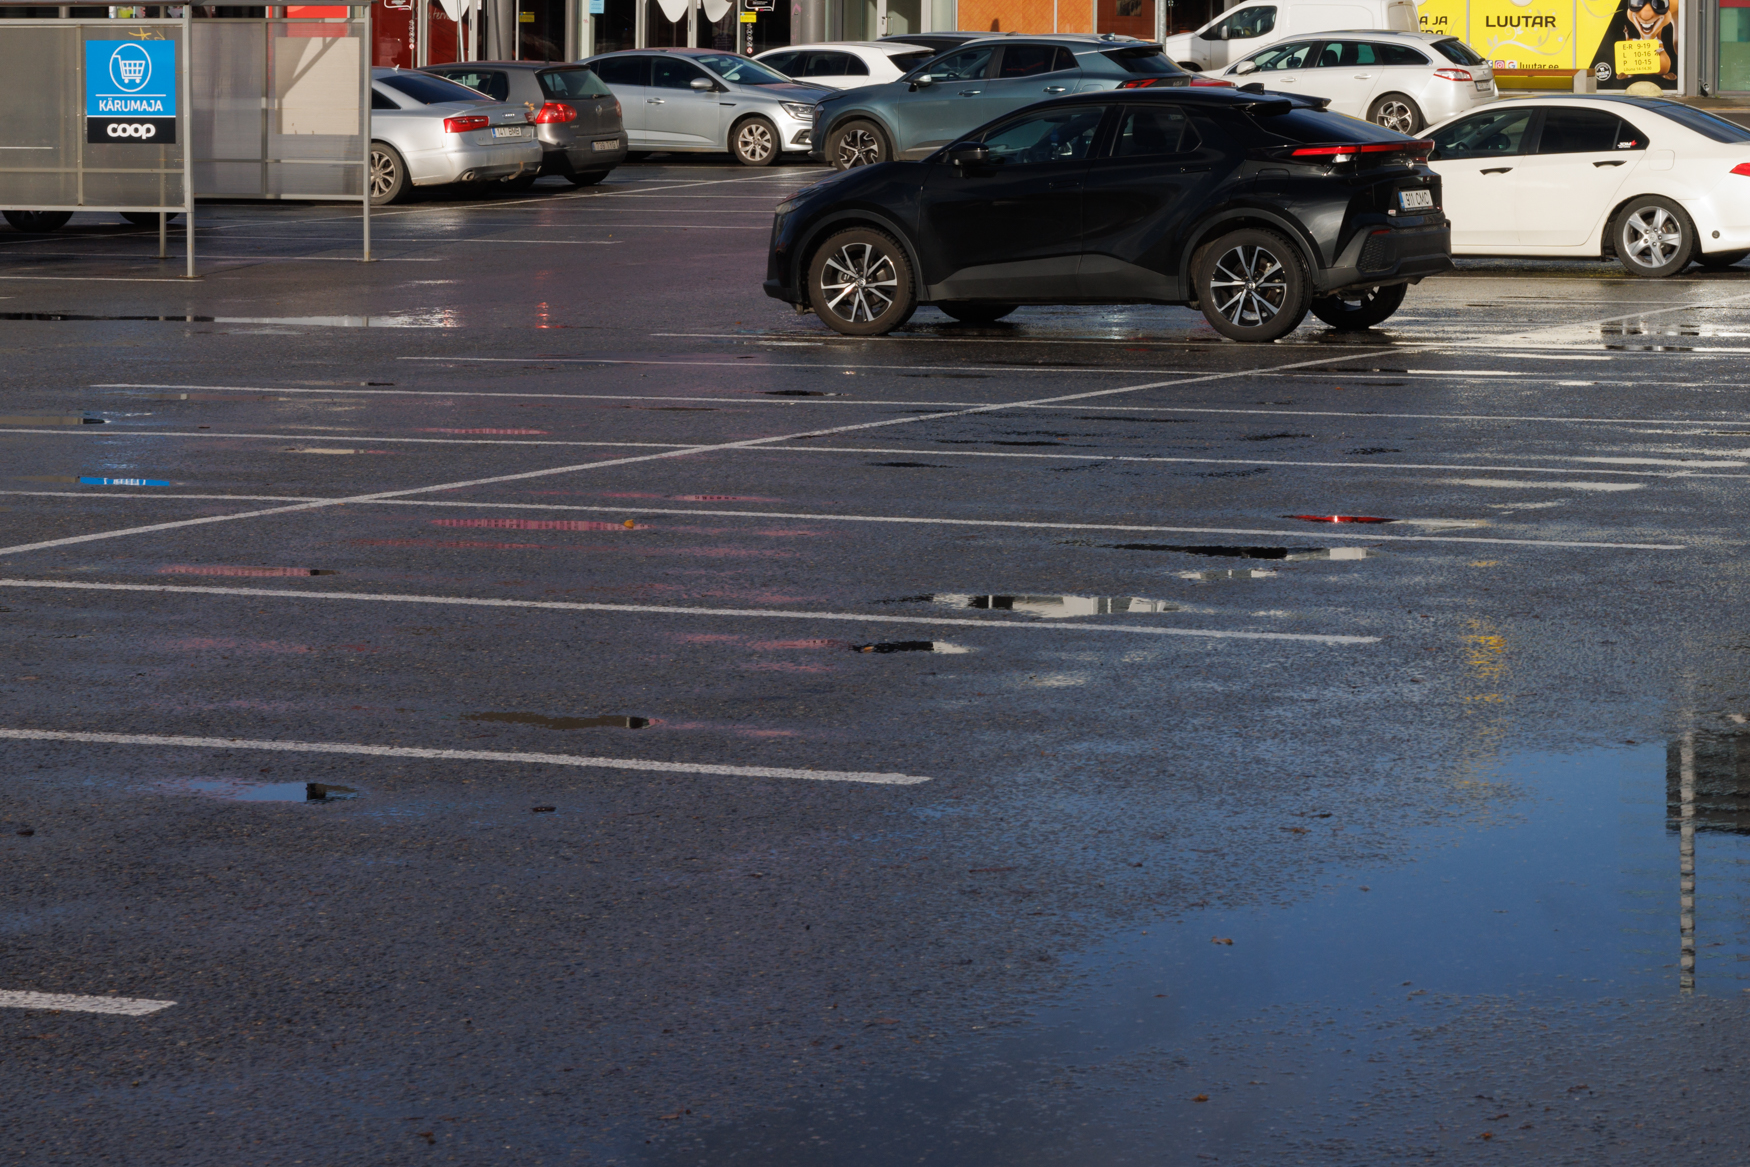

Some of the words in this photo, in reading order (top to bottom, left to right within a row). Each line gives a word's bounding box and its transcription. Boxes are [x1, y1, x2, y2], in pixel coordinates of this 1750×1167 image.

[1485, 15, 1557, 28] LUUTAR
[98, 97, 164, 112] KÄRUMAJA
[106, 123, 156, 139] coop
